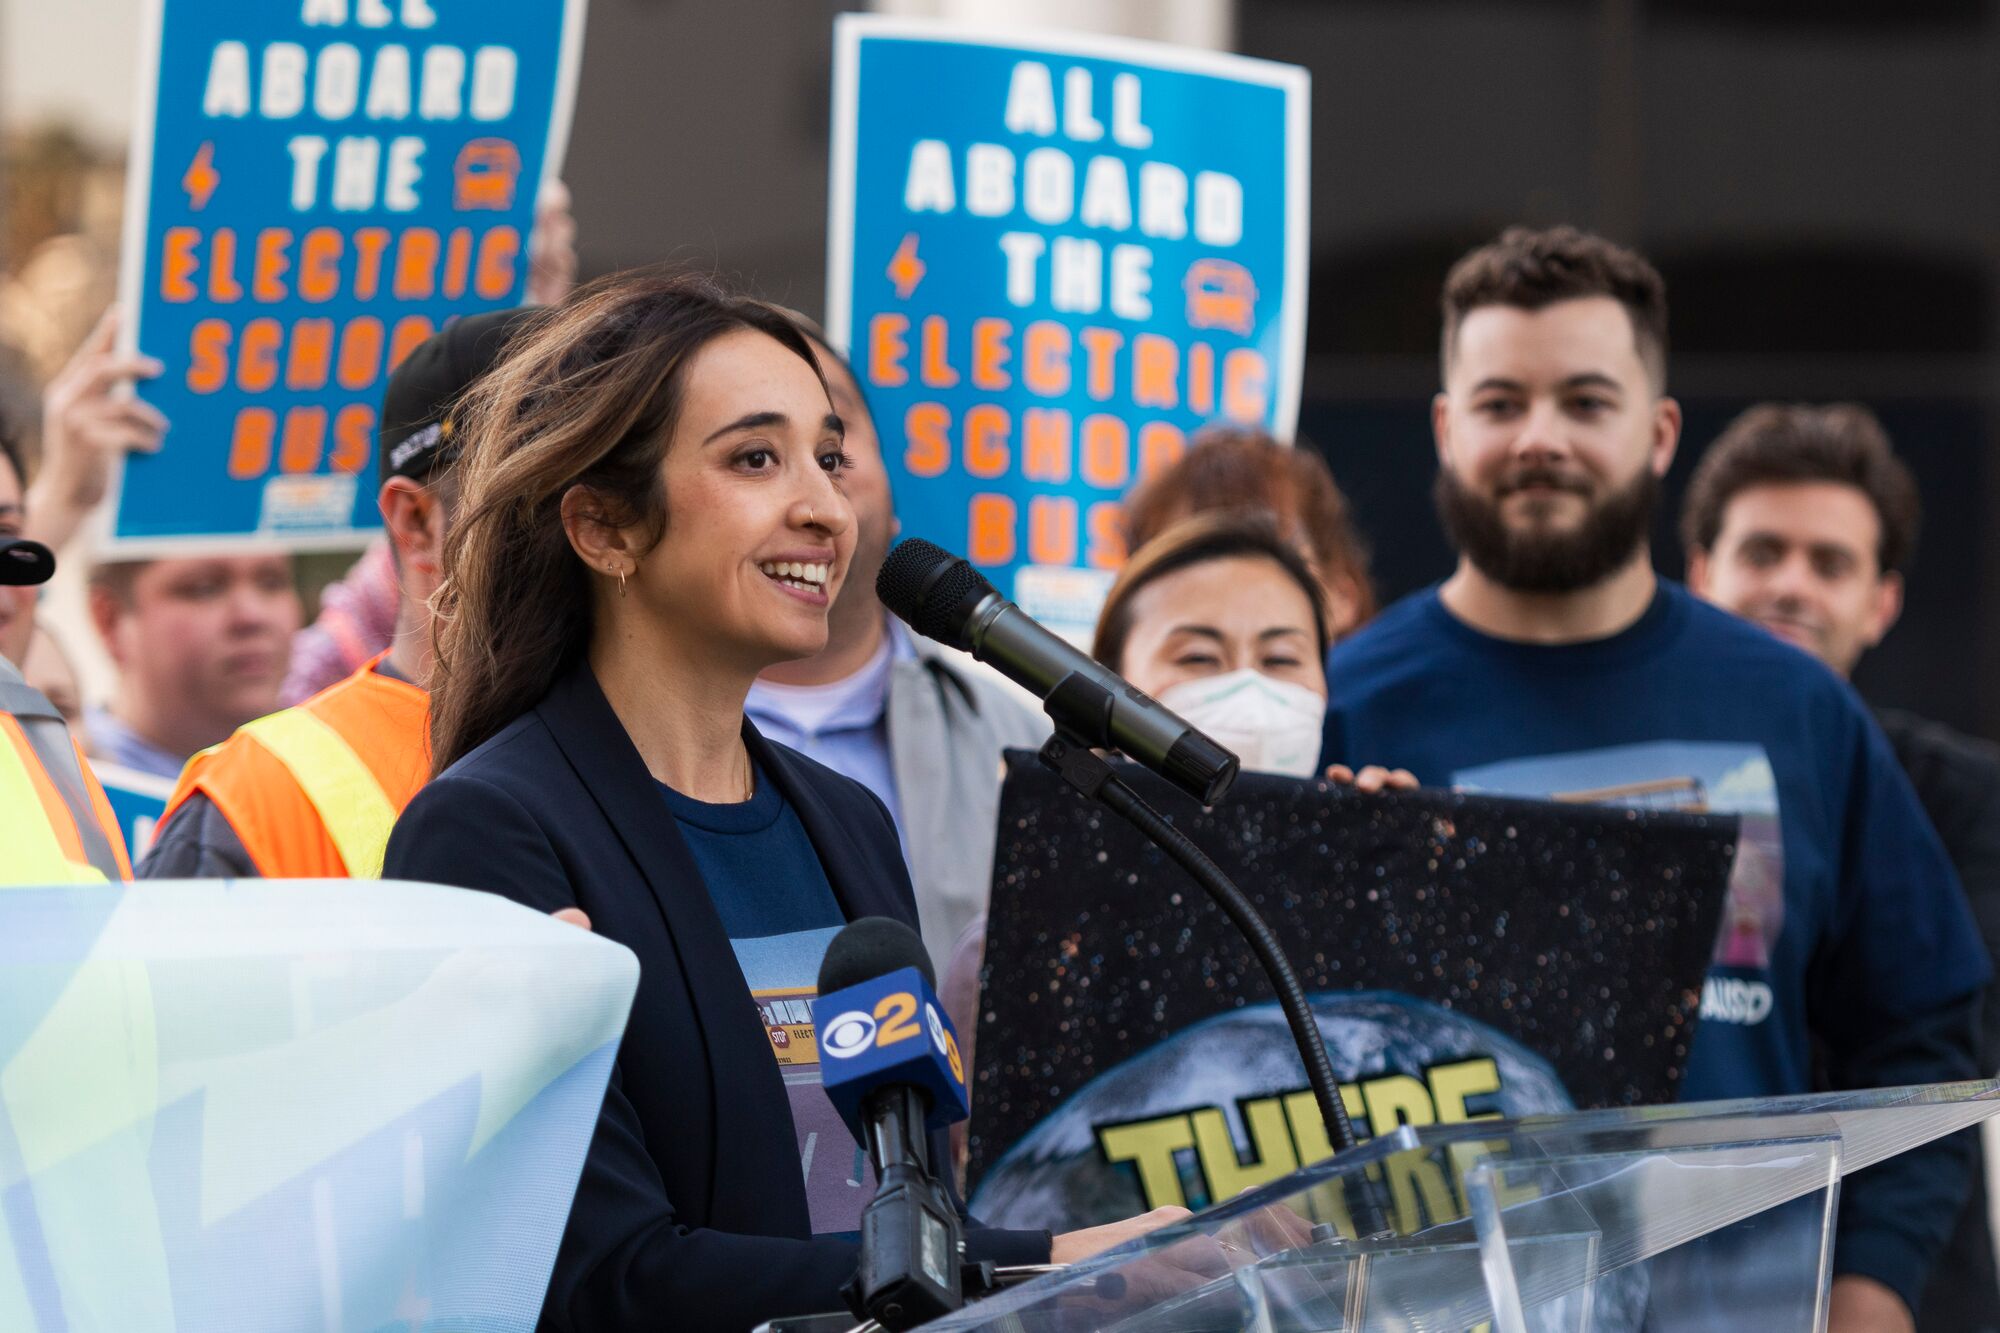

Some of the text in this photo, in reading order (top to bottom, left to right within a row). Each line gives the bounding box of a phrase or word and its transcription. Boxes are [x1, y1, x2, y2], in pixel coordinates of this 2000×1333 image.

[203, 41, 517, 120] ABOARD
[1004, 60, 1154, 149] ALL
[289, 136, 426, 211] THE
[904, 139, 1244, 247] ABOARD
[161, 227, 520, 302] ELECTRIC
[999, 232, 1154, 321] THE
[187, 315, 460, 393] SCHOO
[868, 312, 1268, 424] ELECTRIC
[228, 404, 375, 479] BUS
[904, 403, 1190, 488] SCHOO
[771, 1030, 787, 1043] STOP
[874, 992, 921, 1047] 2
[1102, 1058, 1540, 1242] THERE
